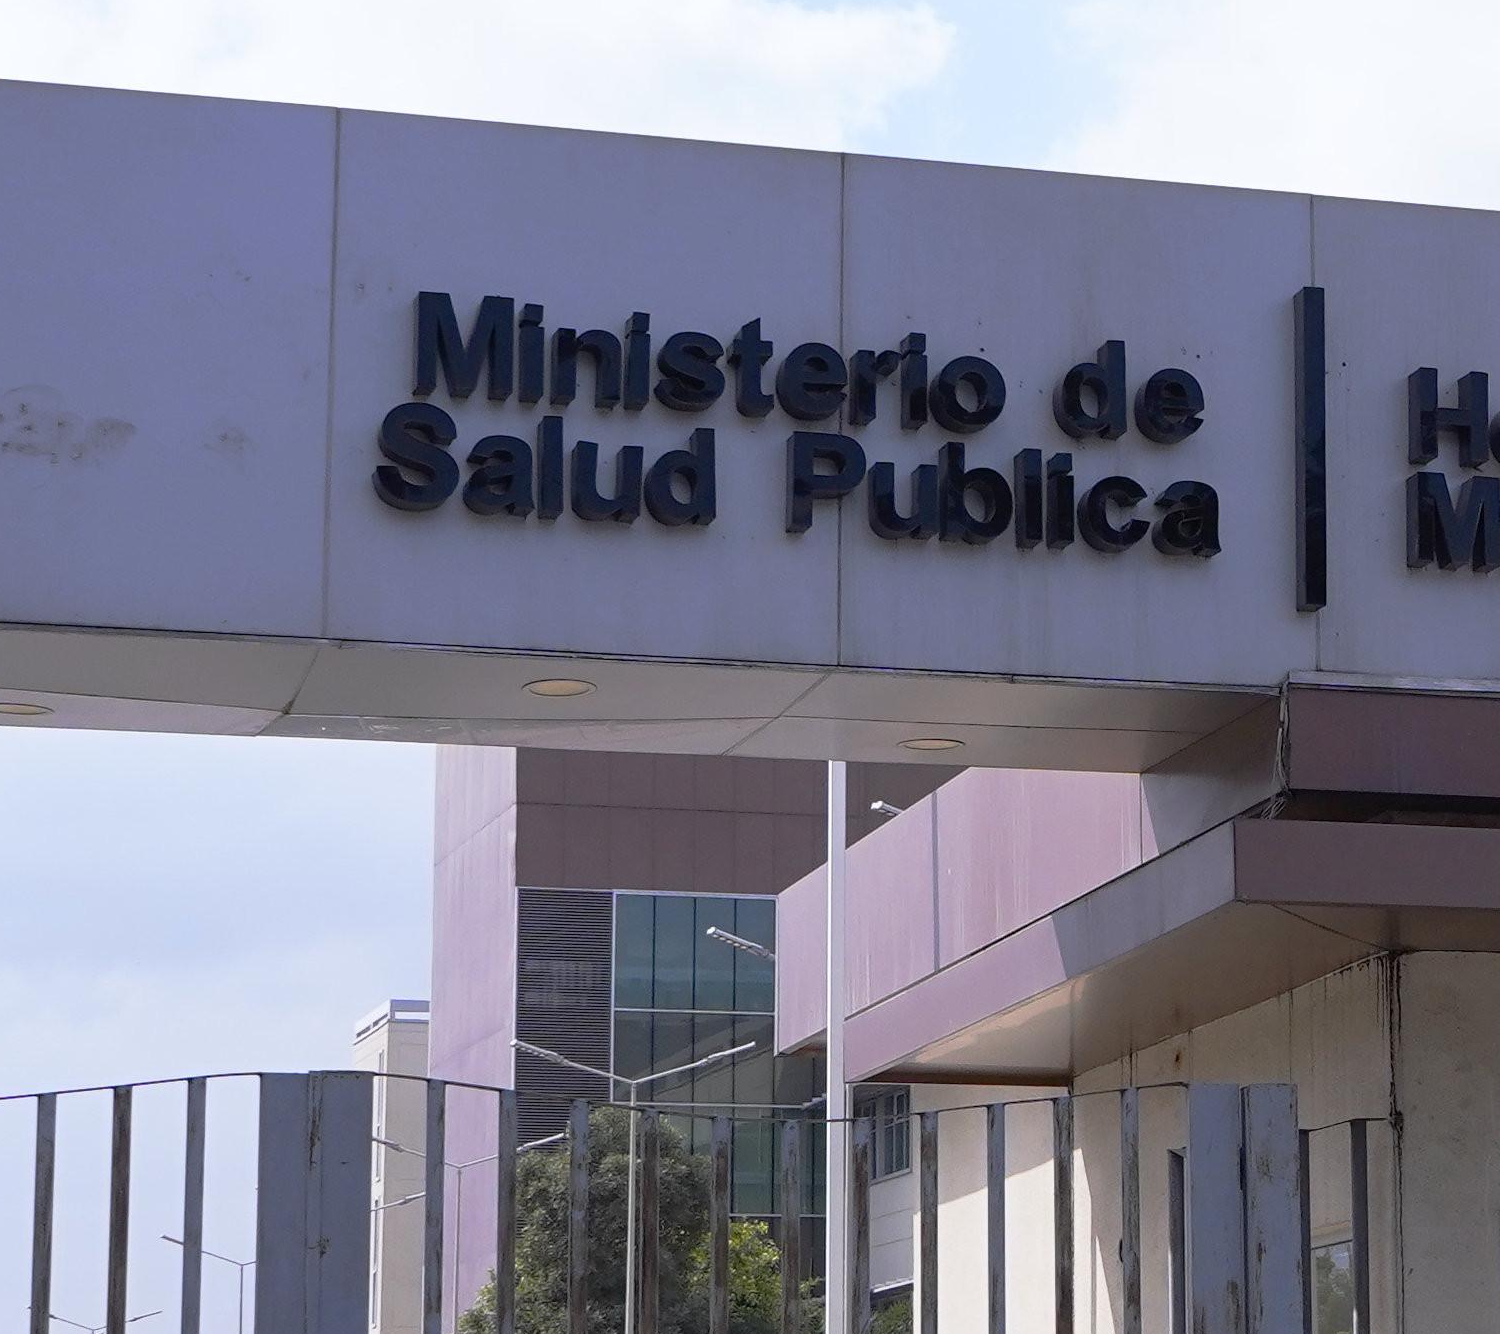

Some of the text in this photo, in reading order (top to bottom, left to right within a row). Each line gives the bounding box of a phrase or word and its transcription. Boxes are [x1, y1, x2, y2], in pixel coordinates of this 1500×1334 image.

[412, 291, 1206, 445] Ministerio de
[371, 402, 1222, 559] Salud Publica
